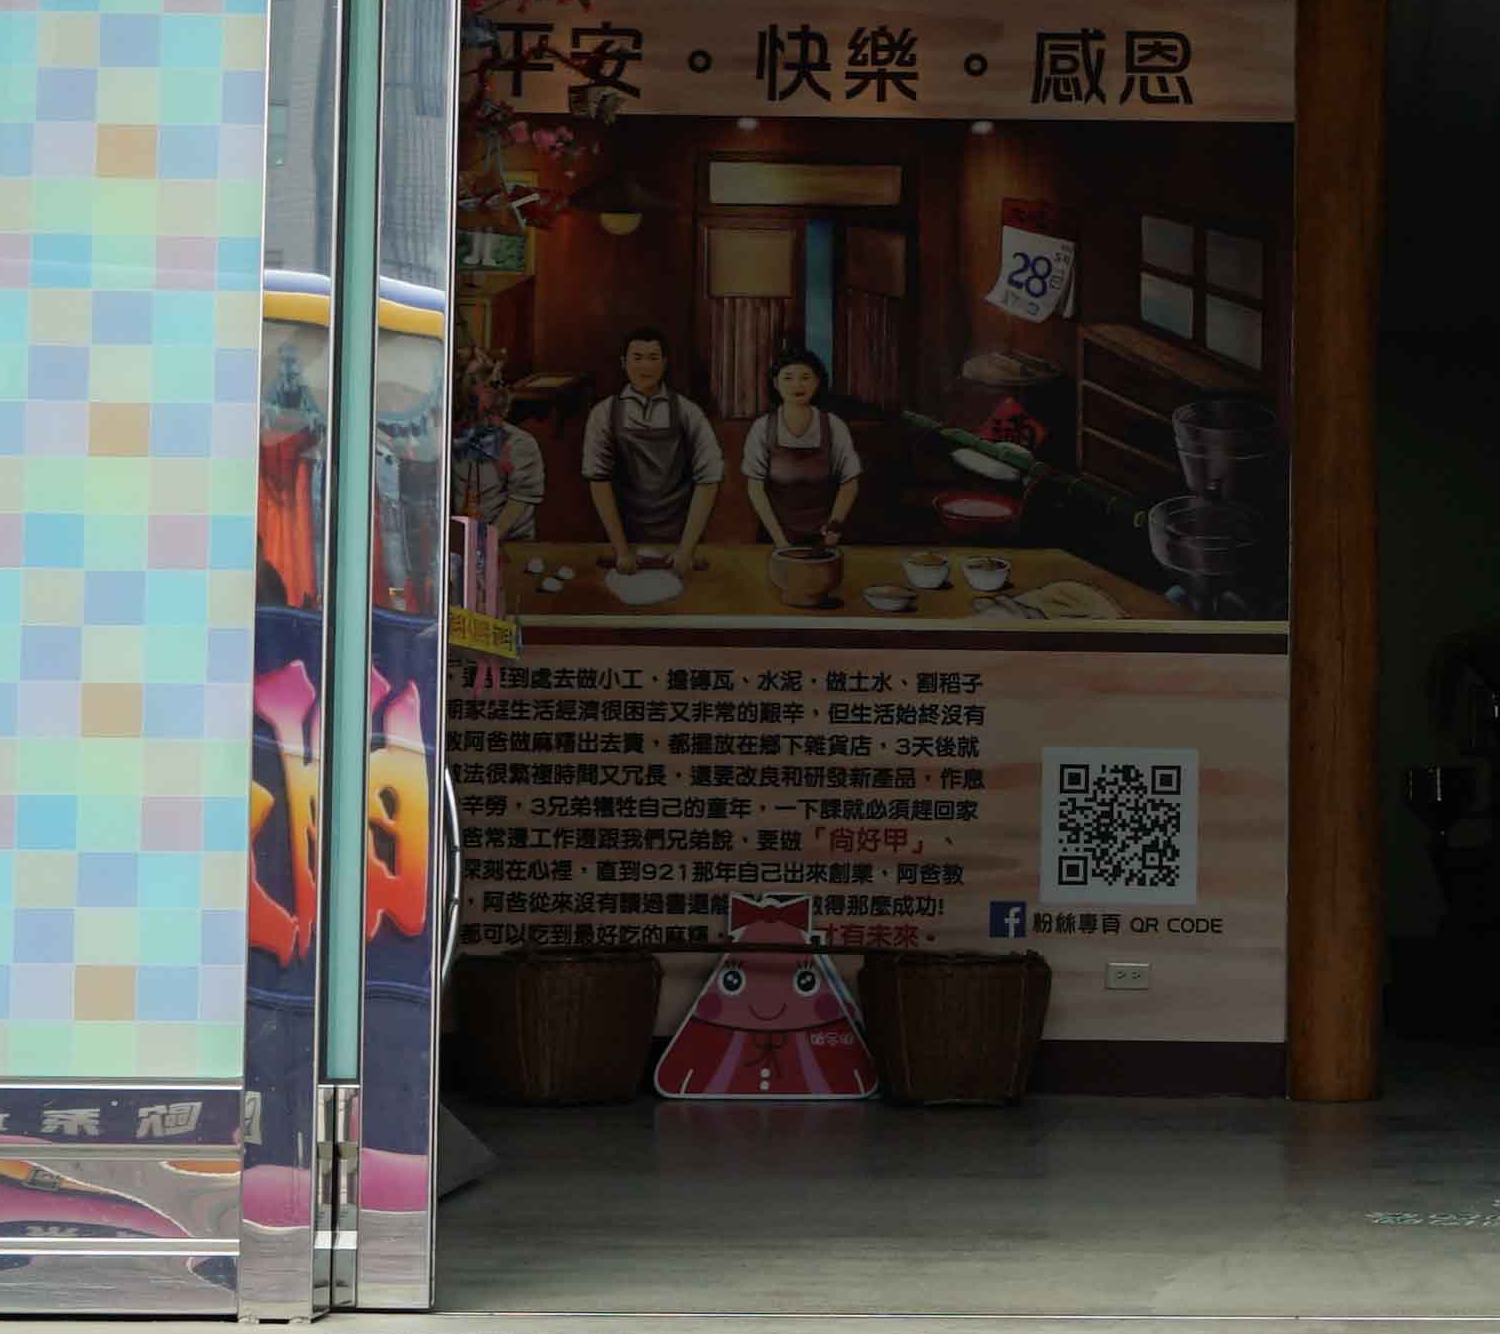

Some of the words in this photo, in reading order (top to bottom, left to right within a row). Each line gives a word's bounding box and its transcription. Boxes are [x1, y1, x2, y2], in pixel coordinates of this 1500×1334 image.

[1008, 252, 1052, 298] 28
[1130, 917, 1159, 934] QR
[1167, 917, 1223, 934] CODE
